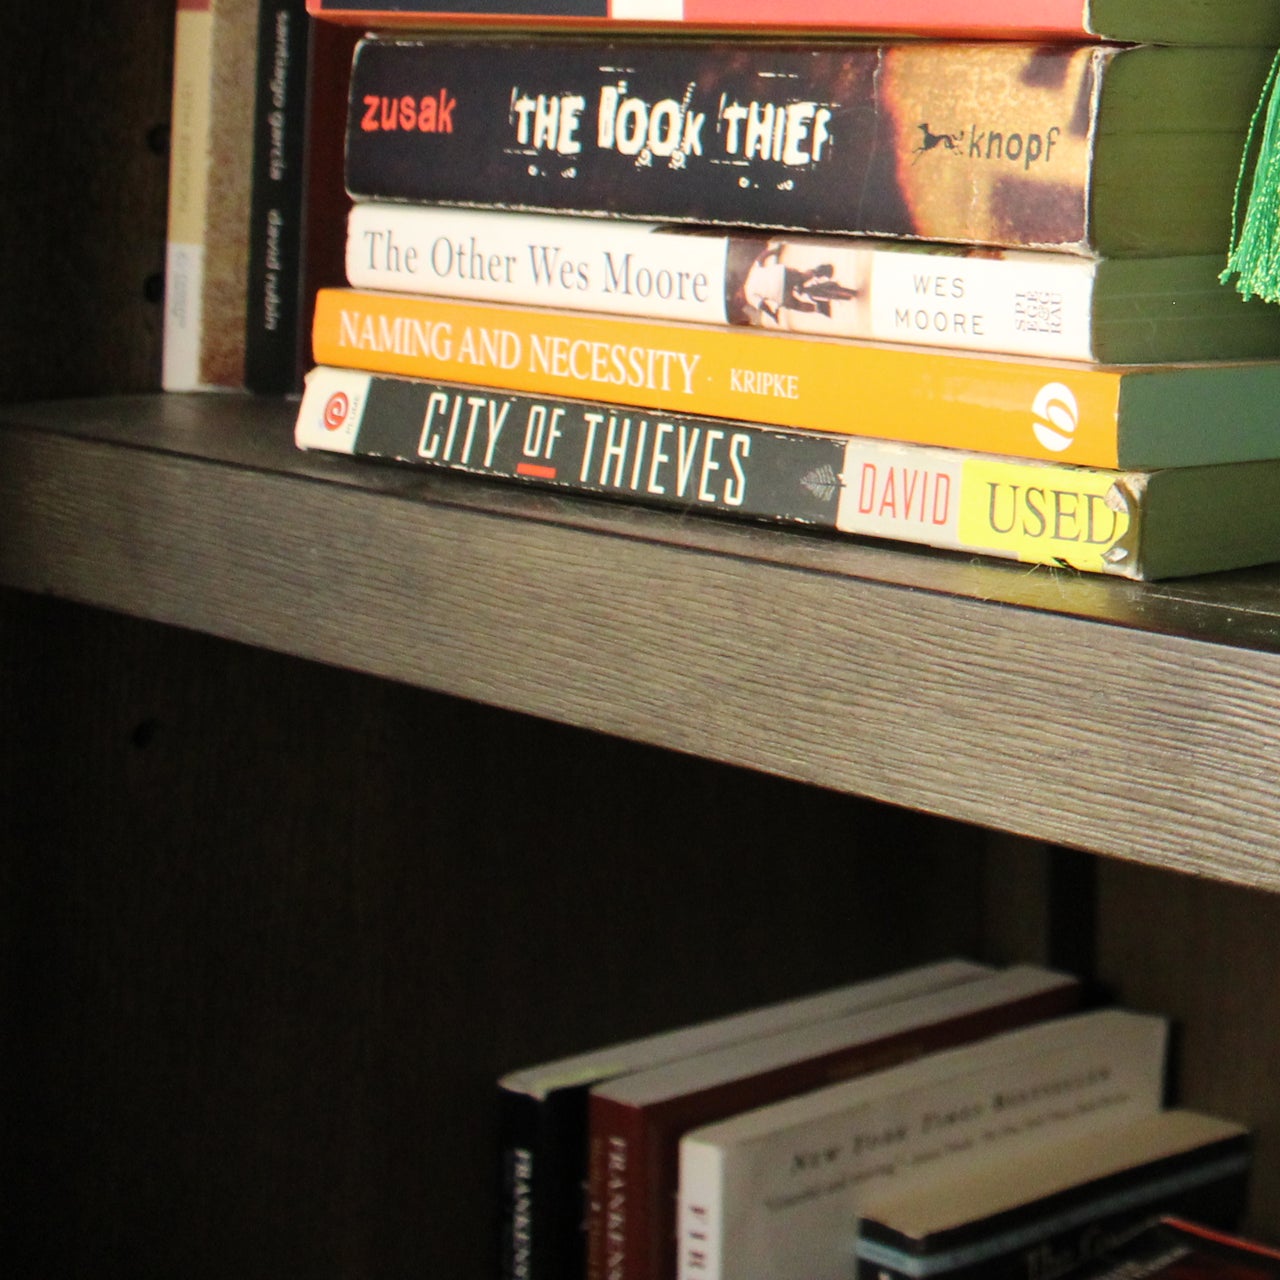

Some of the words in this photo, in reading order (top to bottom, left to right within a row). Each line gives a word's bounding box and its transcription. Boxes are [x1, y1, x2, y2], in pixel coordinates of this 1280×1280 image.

[360, 88, 457, 134] zusak
[514, 93, 585, 156] THE
[967, 125, 1061, 172] knopf
[363, 230, 418, 275] The
[430, 235, 516, 283] Other
[529, 244, 589, 291] Wes
[602, 250, 710, 304] Moore
[914, 271, 966, 299] WES
[339, 309, 452, 363] NAMING
[458, 325, 522, 371] AND
[529, 334, 702, 396] NECESSITY
[730, 365, 800, 402] KRIPKE
[895, 307, 986, 337] MOORE
[418, 392, 513, 467] CITY
[523, 404, 566, 459] OF
[579, 410, 752, 507] THIEVES
[858, 461, 950, 527] DAVID
[985, 481, 1118, 546] USED
[685, 1200, 708, 1280] FIR
